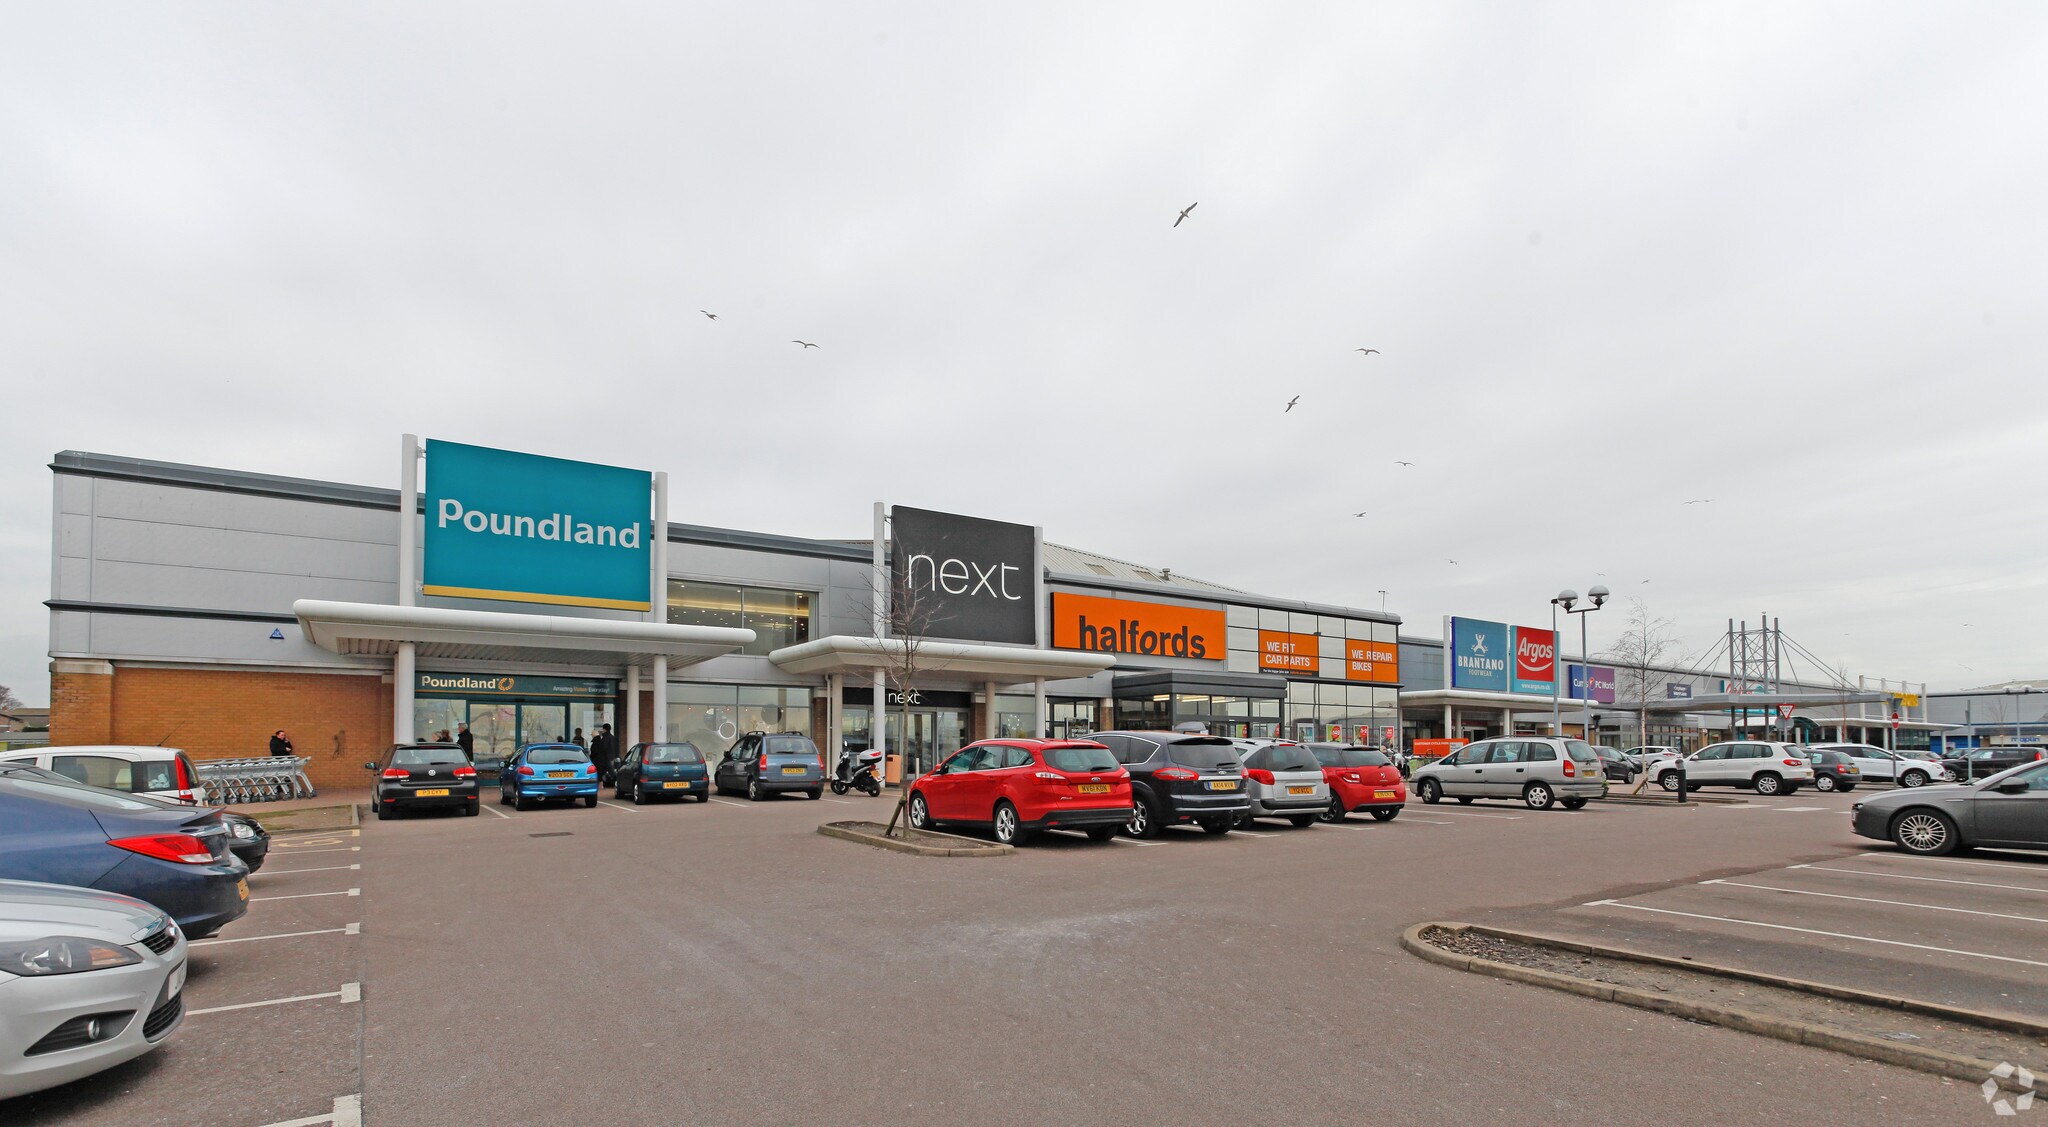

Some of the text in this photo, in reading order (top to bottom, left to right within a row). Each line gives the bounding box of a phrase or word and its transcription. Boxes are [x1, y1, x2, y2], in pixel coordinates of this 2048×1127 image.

[437, 498, 640, 549] Poundland
[908, 554, 1021, 600] next
[1079, 615, 1206, 658] halfords
[1266, 641, 1296, 653] WE FIT
[1517, 636, 1553, 662] Argos
[1265, 654, 1311, 667] CAR PARTS
[1351, 649, 1393, 662] WE REPAIR
[1352, 661, 1373, 672] BIKES
[1457, 655, 1504, 671] BRANTANO
[1468, 668, 1493, 677] FOOTWEAR
[421, 675, 496, 690] Poundland
[888, 692, 920, 704] next
